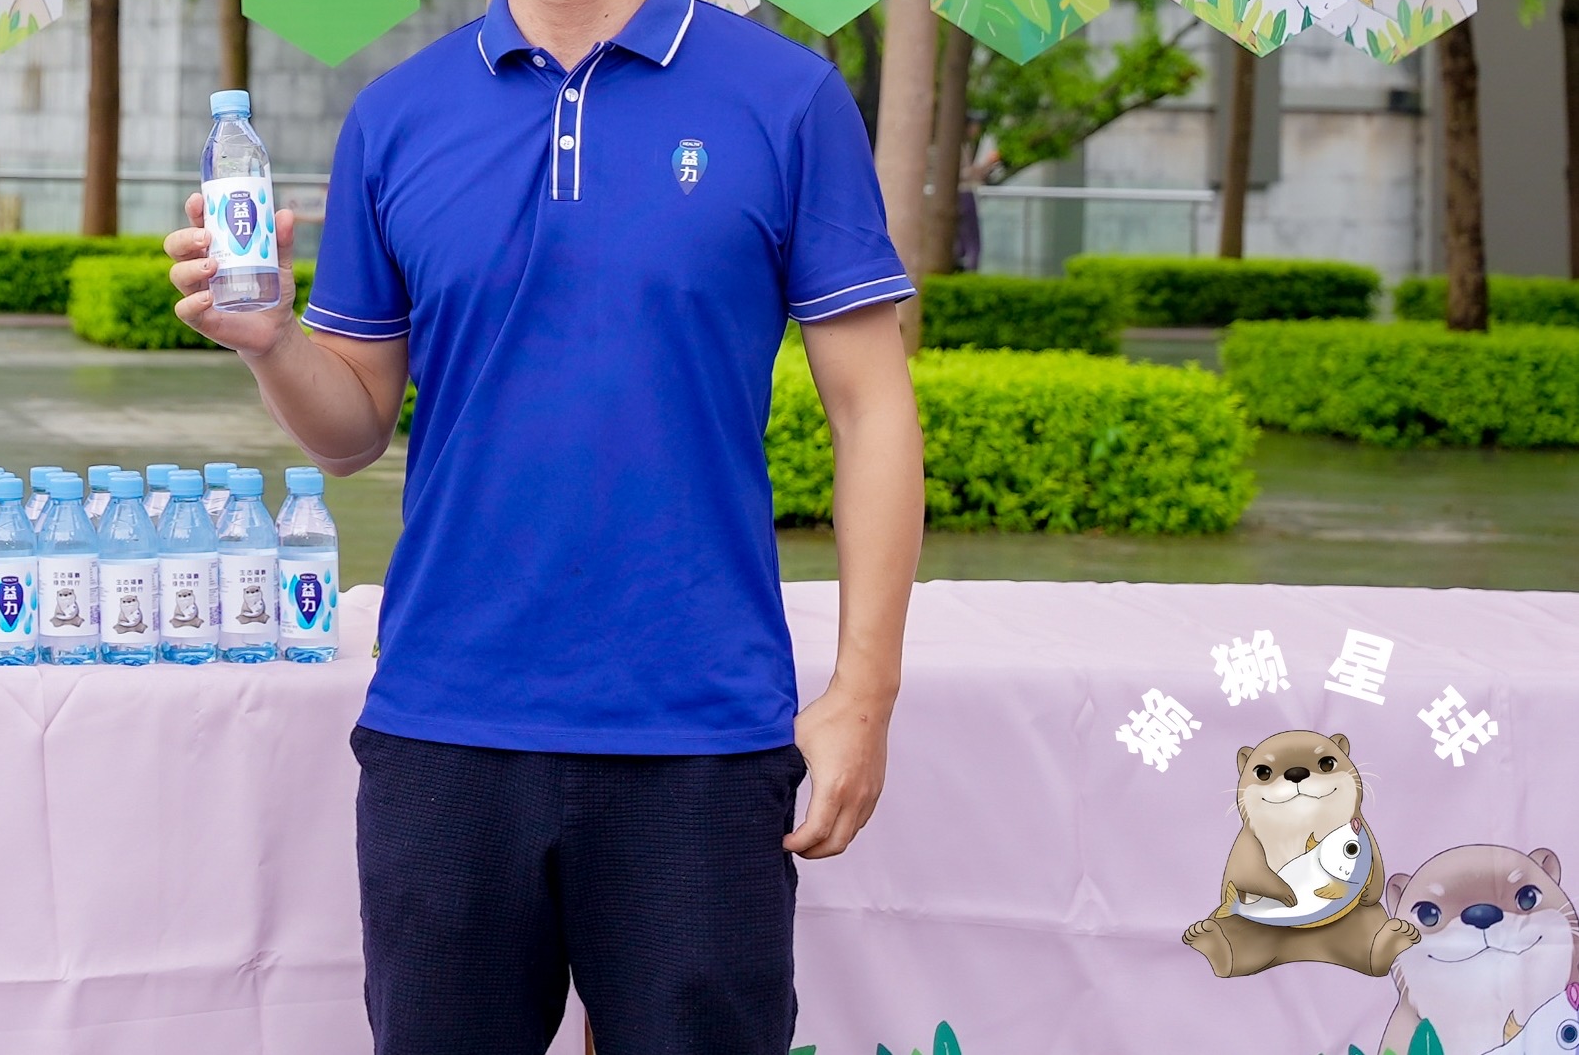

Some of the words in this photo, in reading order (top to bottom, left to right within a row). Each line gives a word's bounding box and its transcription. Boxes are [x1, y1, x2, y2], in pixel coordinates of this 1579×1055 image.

[680, 150, 699, 183] 益力
[233, 202, 252, 236] 益力
[3, 586, 18, 616] 益力
[301, 582, 316, 612] 益力
